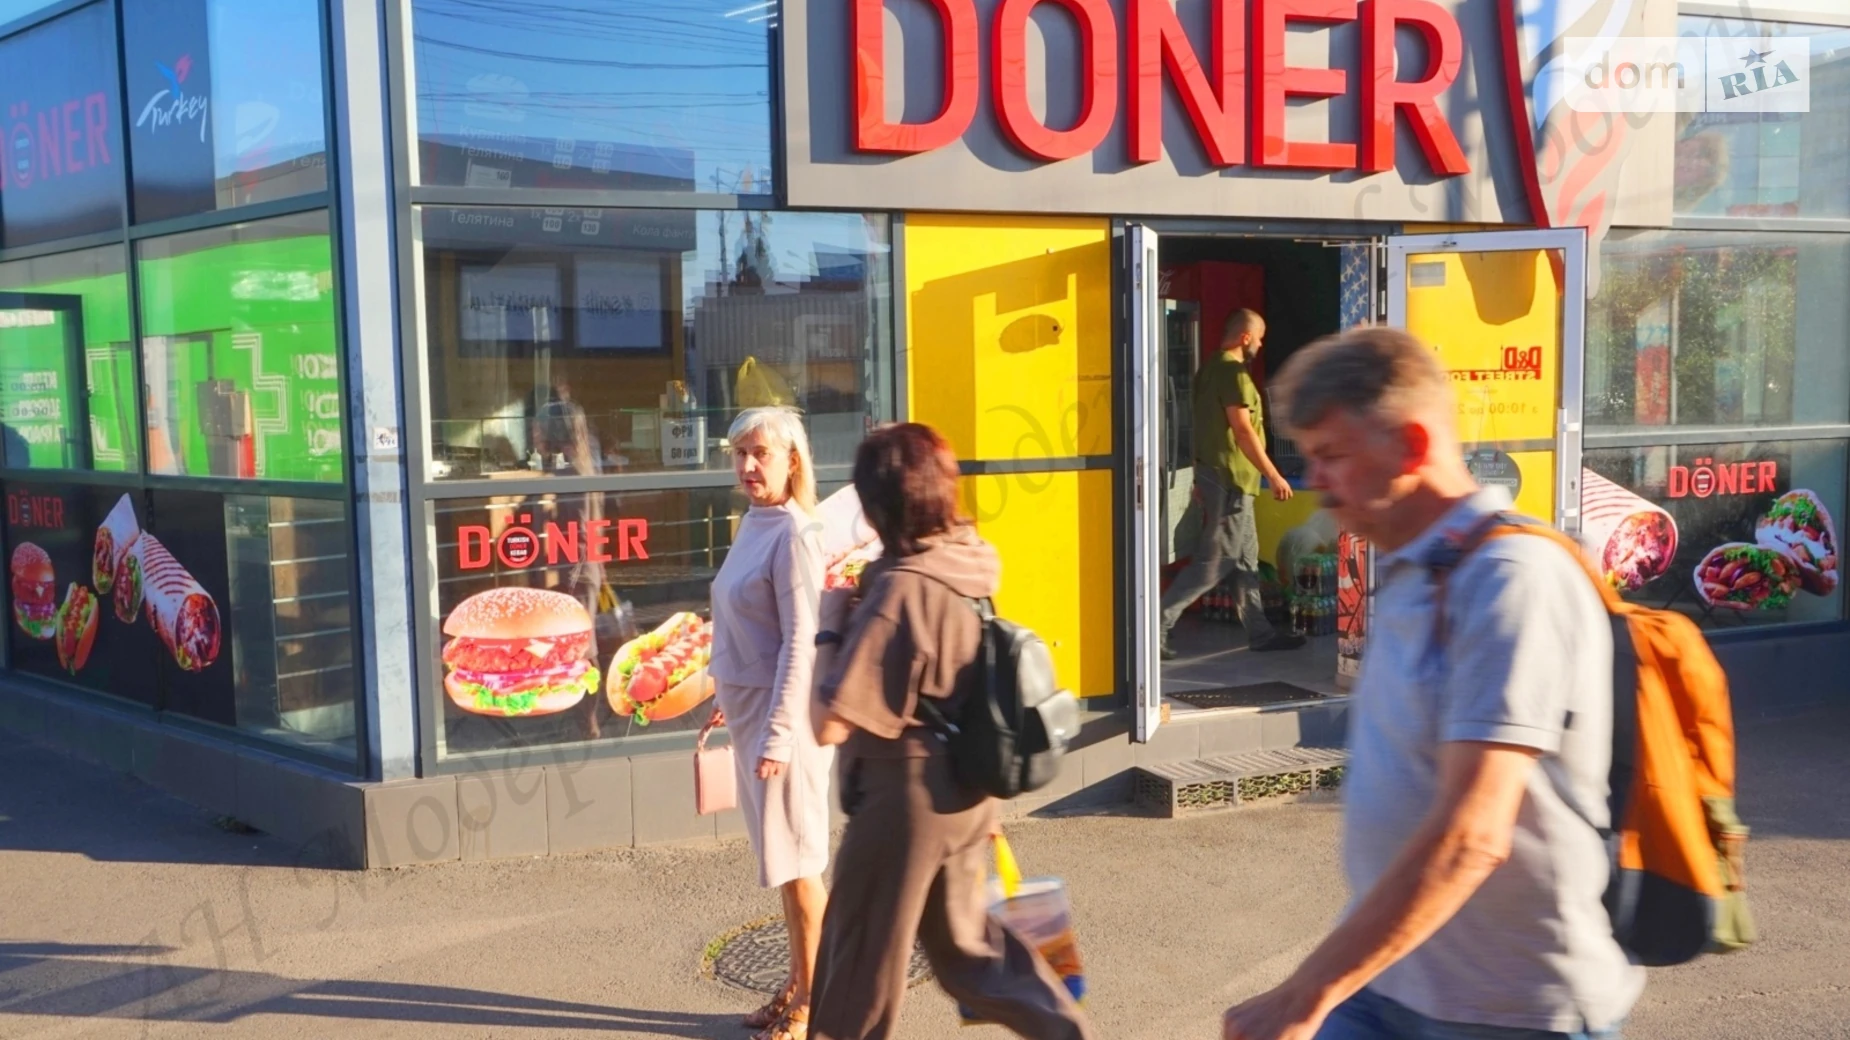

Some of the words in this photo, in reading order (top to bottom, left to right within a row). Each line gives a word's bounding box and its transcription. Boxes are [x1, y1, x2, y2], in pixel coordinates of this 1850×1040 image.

[136, 87, 208, 144] Turkey
[0, 91, 112, 192] ÖNER
[460, 142, 524, 163] Телятина
[449, 208, 515, 228] Телятина
[632, 224, 661, 237] Кола
[1669, 457, 1777, 499] DÖNER
[8, 488, 64, 528] DÖNER
[458, 513, 650, 569] DÖNER
